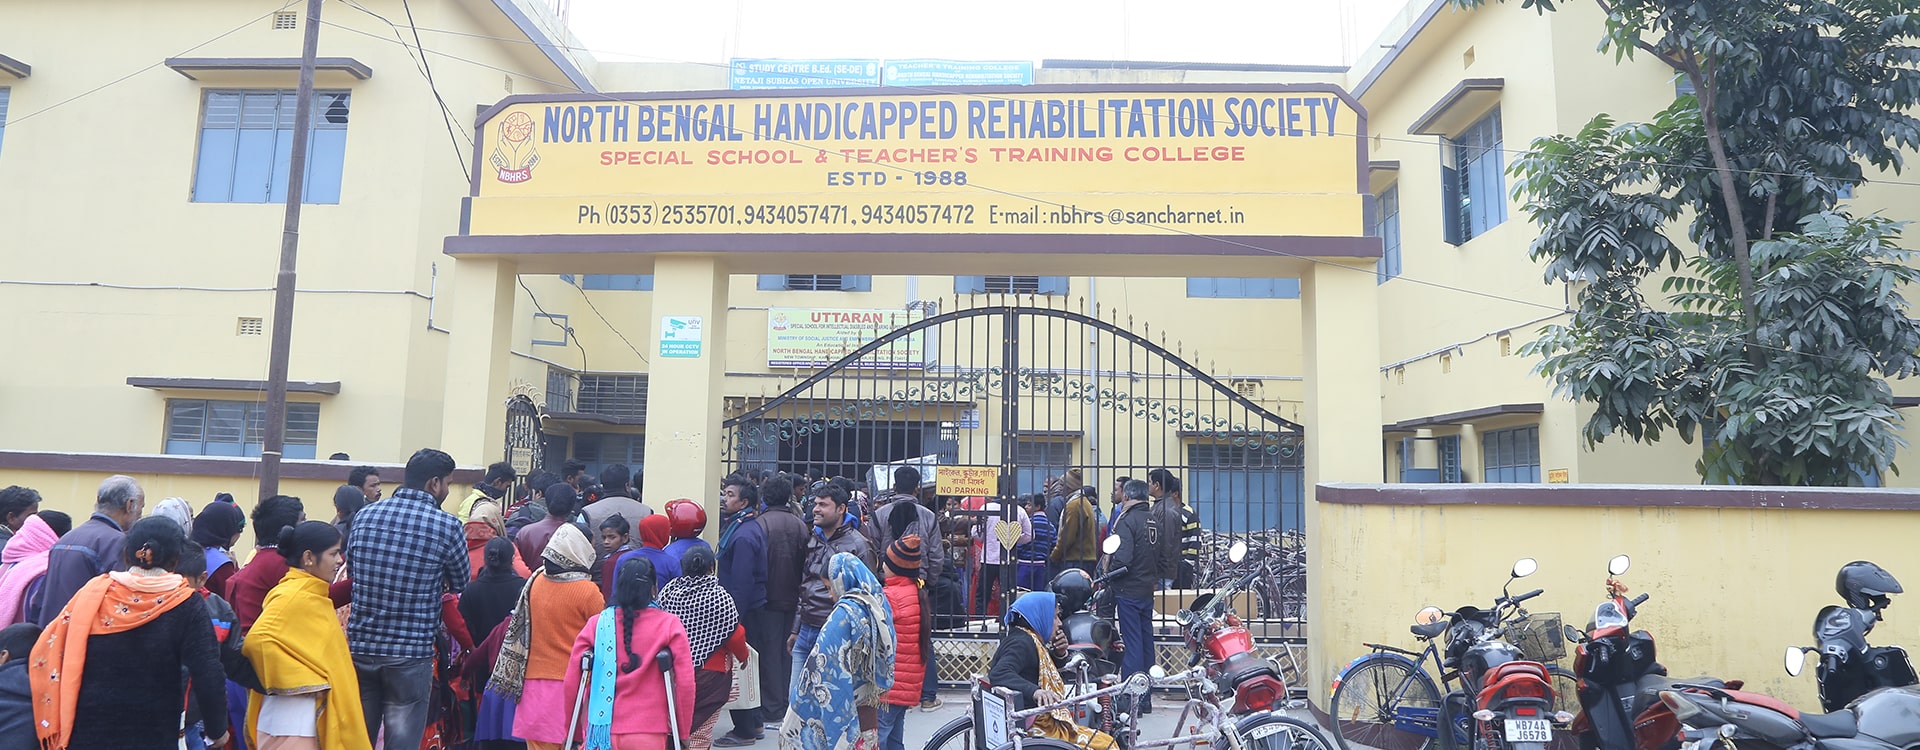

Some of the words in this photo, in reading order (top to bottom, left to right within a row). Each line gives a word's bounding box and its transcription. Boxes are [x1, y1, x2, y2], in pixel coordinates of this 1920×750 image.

[749, 64, 776, 73] STUDY
[777, 64, 809, 73] CENTRE
[811, 64, 832, 73] B.Ed.
[834, 64, 863, 75] (SE-DE)
[766, 77, 799, 85] SUBHAS
[542, 105, 630, 143] NORTH
[637, 104, 743, 143] BENGAL
[753, 101, 958, 141] HANDICAPPED
[967, 98, 1215, 139] REHABILITATION
[1224, 97, 1340, 137] SOCIETY
[600, 150, 694, 166] SPECIAL
[706, 149, 803, 165] SCHOOL
[814, 149, 829, 164] &
[839, 147, 978, 163] TEACHER'S
[989, 146, 1113, 162] TRAINING
[1123, 146, 1246, 162] COLLEGE
[499, 169, 528, 181] NBHRS
[827, 172, 887, 186] ESTD
[914, 170, 968, 186] 1988
[578, 205, 600, 224] Ph
[861, 204, 974, 225] 9434057472
[811, 312, 883, 323] UTTARAN
[940, 486, 952, 494] NO
[955, 487, 989, 495] PARKING
[1515, 721, 1546, 730] WB74A
[1517, 731, 1547, 740] J6578
